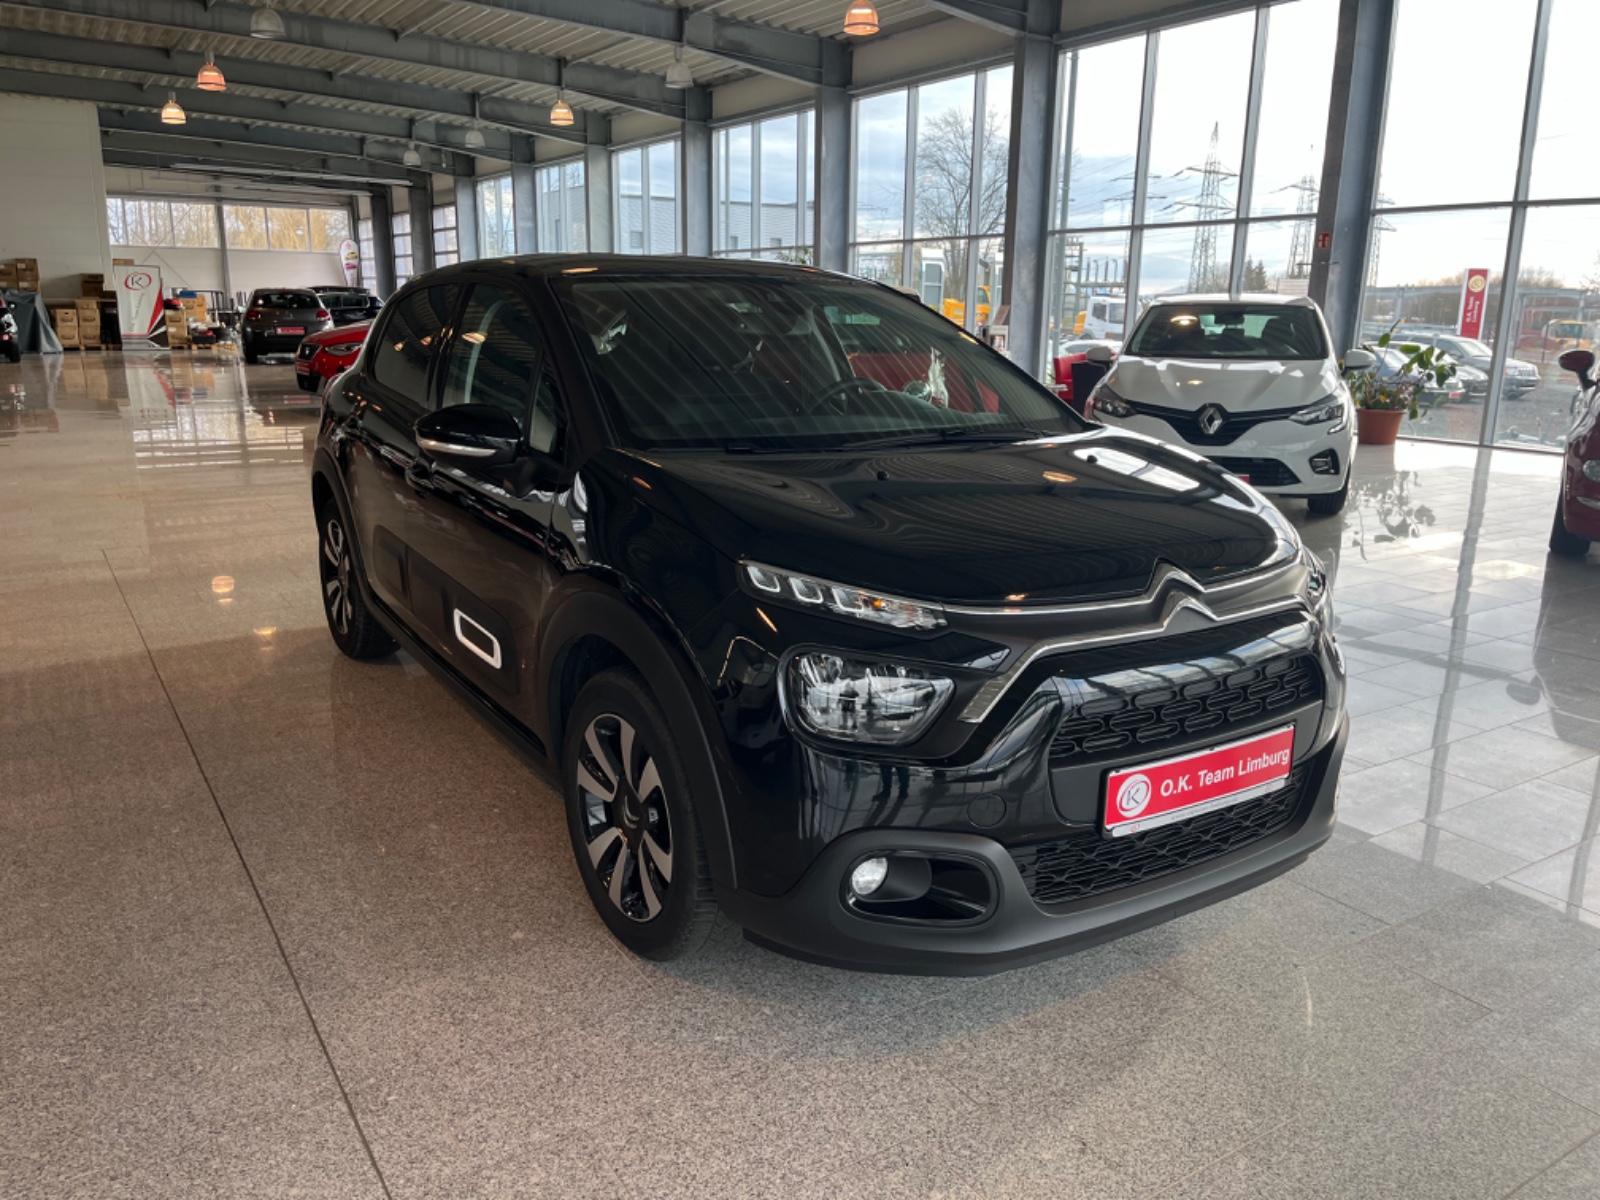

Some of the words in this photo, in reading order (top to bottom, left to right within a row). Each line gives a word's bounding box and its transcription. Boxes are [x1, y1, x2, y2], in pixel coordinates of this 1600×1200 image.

[1160, 774, 1193, 797] O.K.
[1198, 765, 1234, 787] Team
[1238, 748, 1290, 775] Limburg
